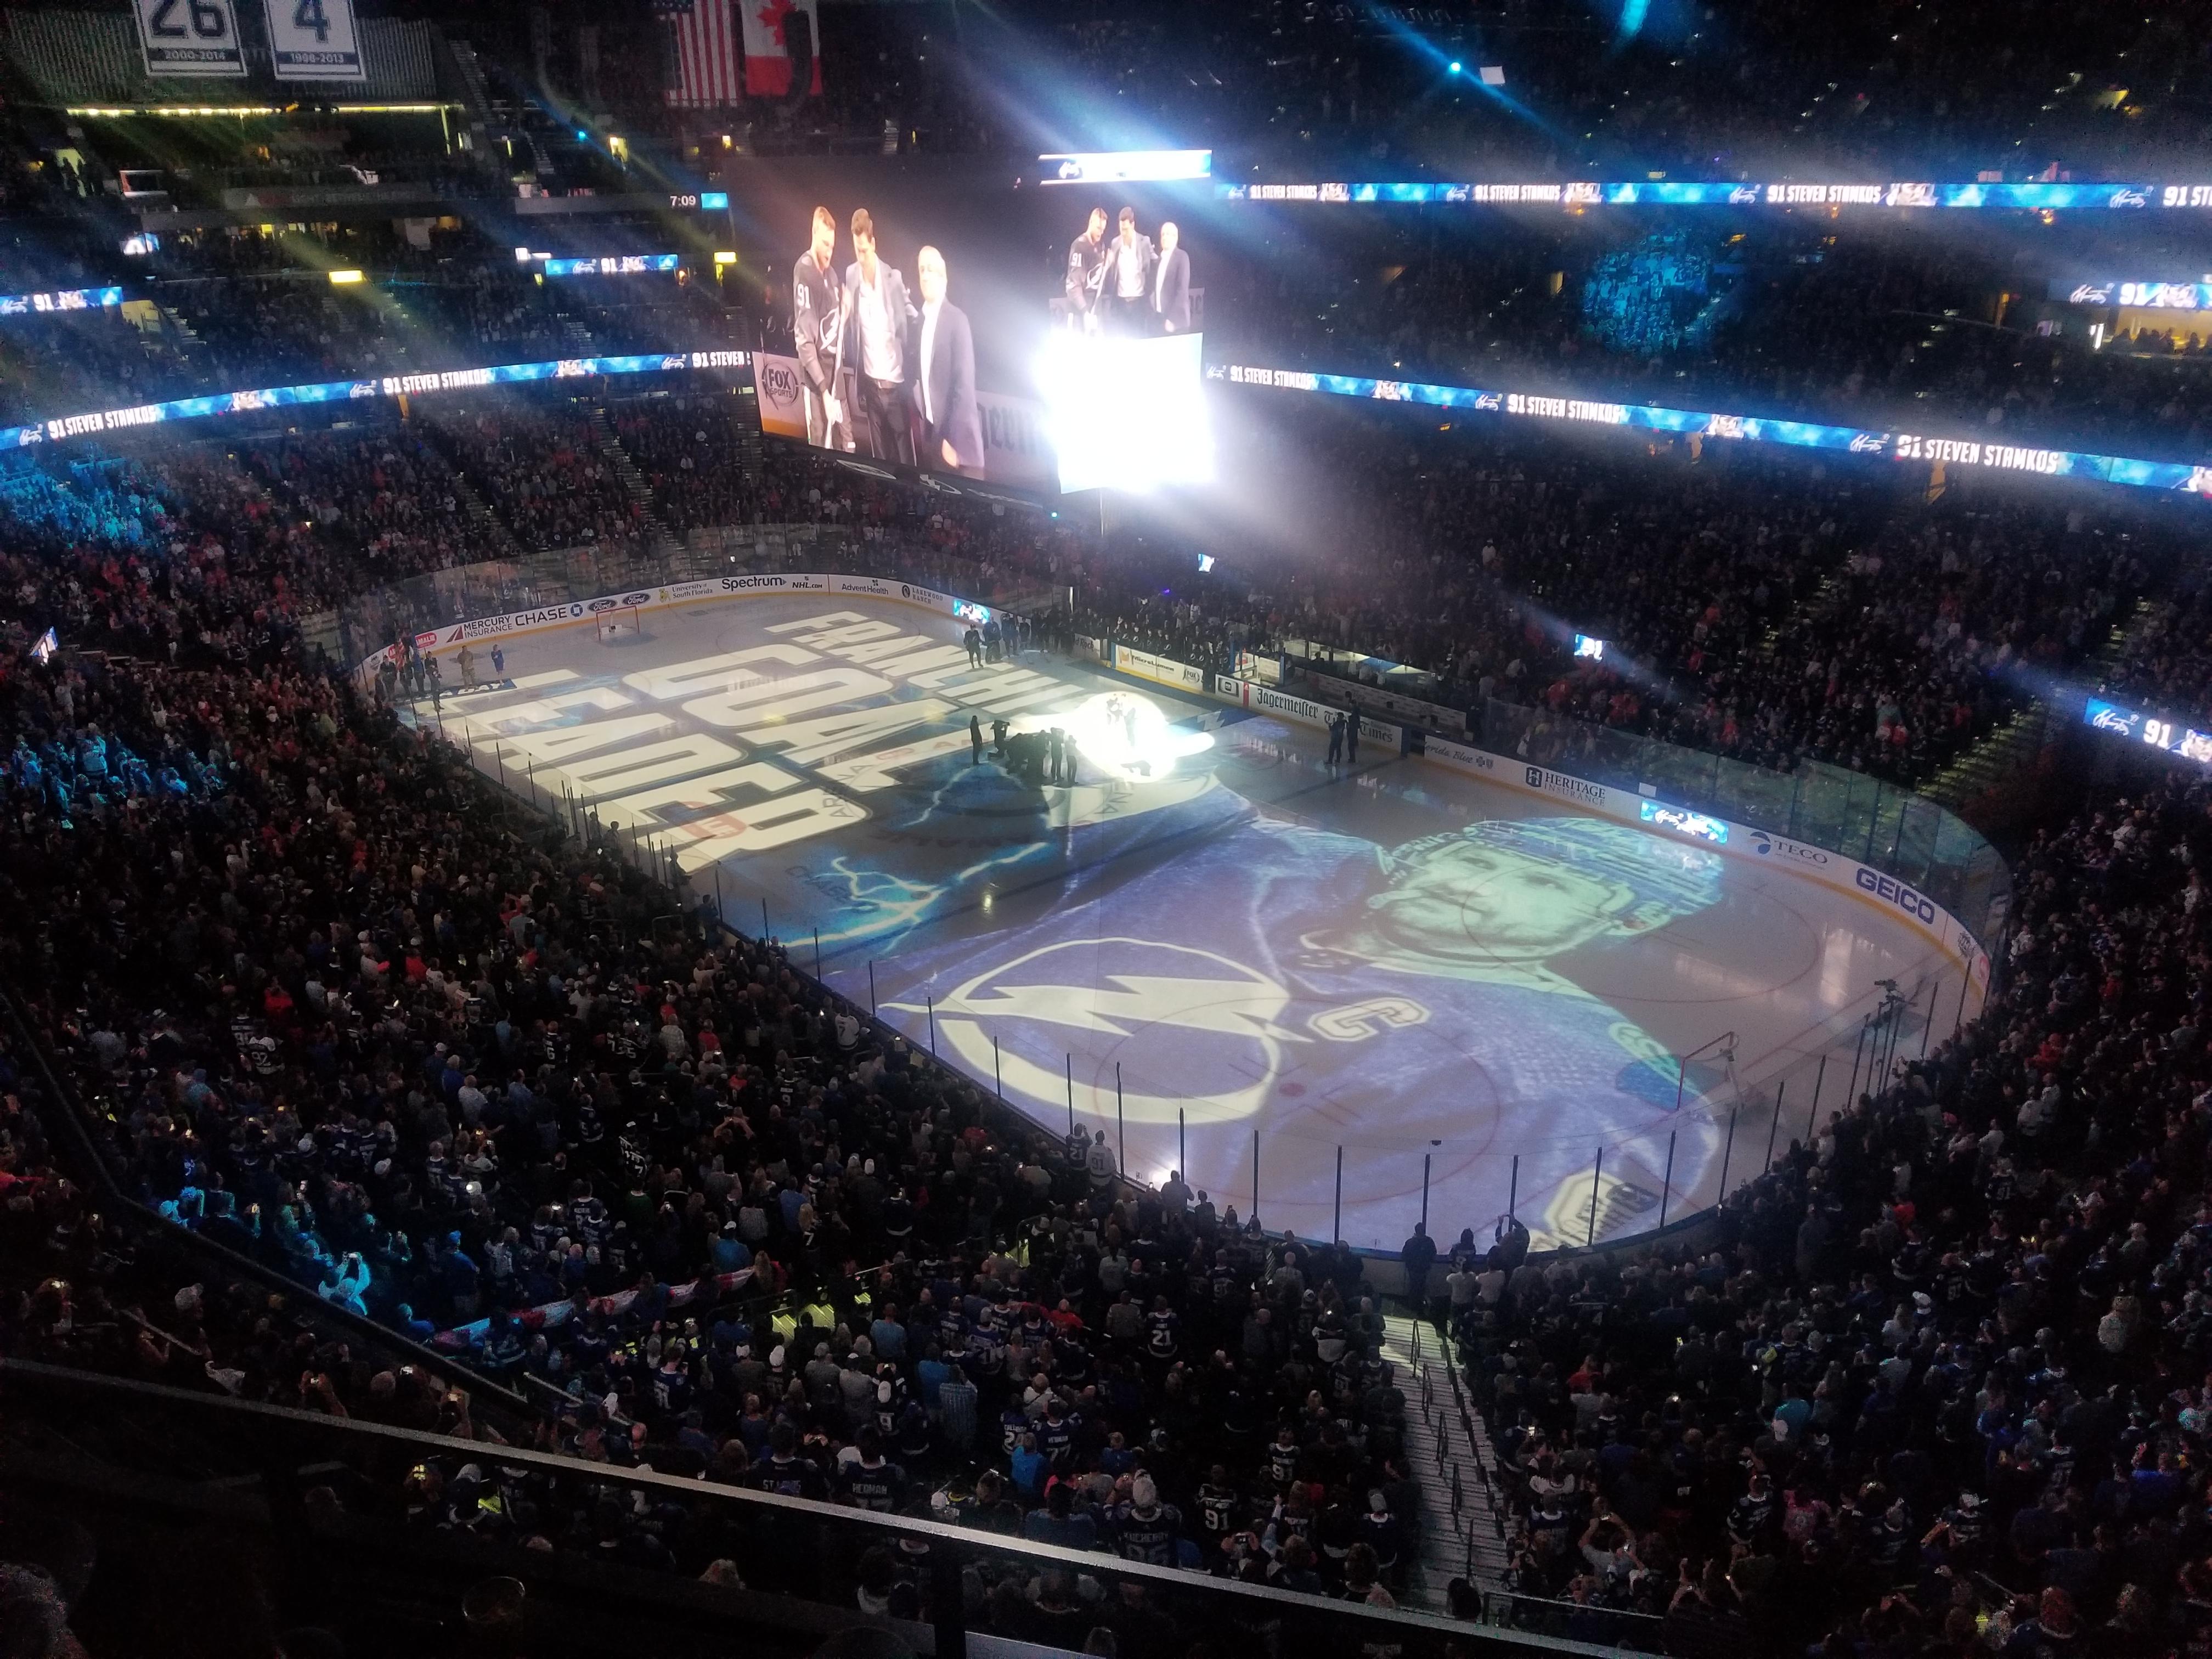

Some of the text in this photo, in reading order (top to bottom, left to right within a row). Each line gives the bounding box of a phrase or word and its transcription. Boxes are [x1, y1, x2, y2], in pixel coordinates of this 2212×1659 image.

[670, 195, 696, 206] 7:09
[1491, 185, 1520, 200] STEVEN
[1521, 185, 1561, 200] STAMKOS
[1768, 185, 1785, 202] 91
[1787, 185, 1827, 202] STEVEN
[1829, 185, 1881, 203] STAMKOS
[2163, 187, 2187, 206] 91
[1071, 252, 1082, 267] 91
[33, 293, 53, 311] 91
[797, 283, 810, 309] 91
[692, 352, 709, 367] 91
[710, 351, 745, 366] STEVEN
[382, 377, 402, 394] 91
[403, 374, 439, 390] STEVEN
[441, 368, 487, 386] STAMKOS
[769, 369, 792, 390] FOX
[1230, 366, 1244, 381] 91
[1244, 368, 1273, 385] STEVEN
[771, 387, 793, 398] SPORTS
[1508, 394, 1526, 413] 91
[1527, 396, 1566, 417] STEVEN
[1568, 400, 1620, 423] STAMKOS
[47, 420, 65, 438] 91
[65, 413, 103, 434] STEVEN
[105, 405, 156, 429] STAMKOS
[1925, 439, 1979, 463] STEVEN
[1983, 444, 2058, 473] STAMKOS
[673, 585, 702, 593] University
[692, 588, 713, 597] Florida
[721, 576, 783, 591] Spectrum
[842, 583, 889, 595] AdventHealth
[591, 602, 613, 612] Ford
[628, 594, 650, 604] Ford
[464, 616, 511, 632] MERCURY
[515, 607, 567, 627] CHASE
[465, 623, 513, 639] INSURANCE
[1187, 670, 1197, 679] FOX
[1360, 721, 1392, 742] Times
[2143, 719, 2171, 748] 91
[1453, 751, 1473, 763] Blue
[1544, 782, 1604, 807] INSURANCE
[1545, 772, 1605, 799] HERITAGE
[1775, 840, 1827, 864] TECO
[1857, 867, 1935, 925] GEICO
[1152, 1329, 1171, 1346] 21
[763, 1479, 774, 1489] ST
[1205, 1509, 1229, 1530] 91
